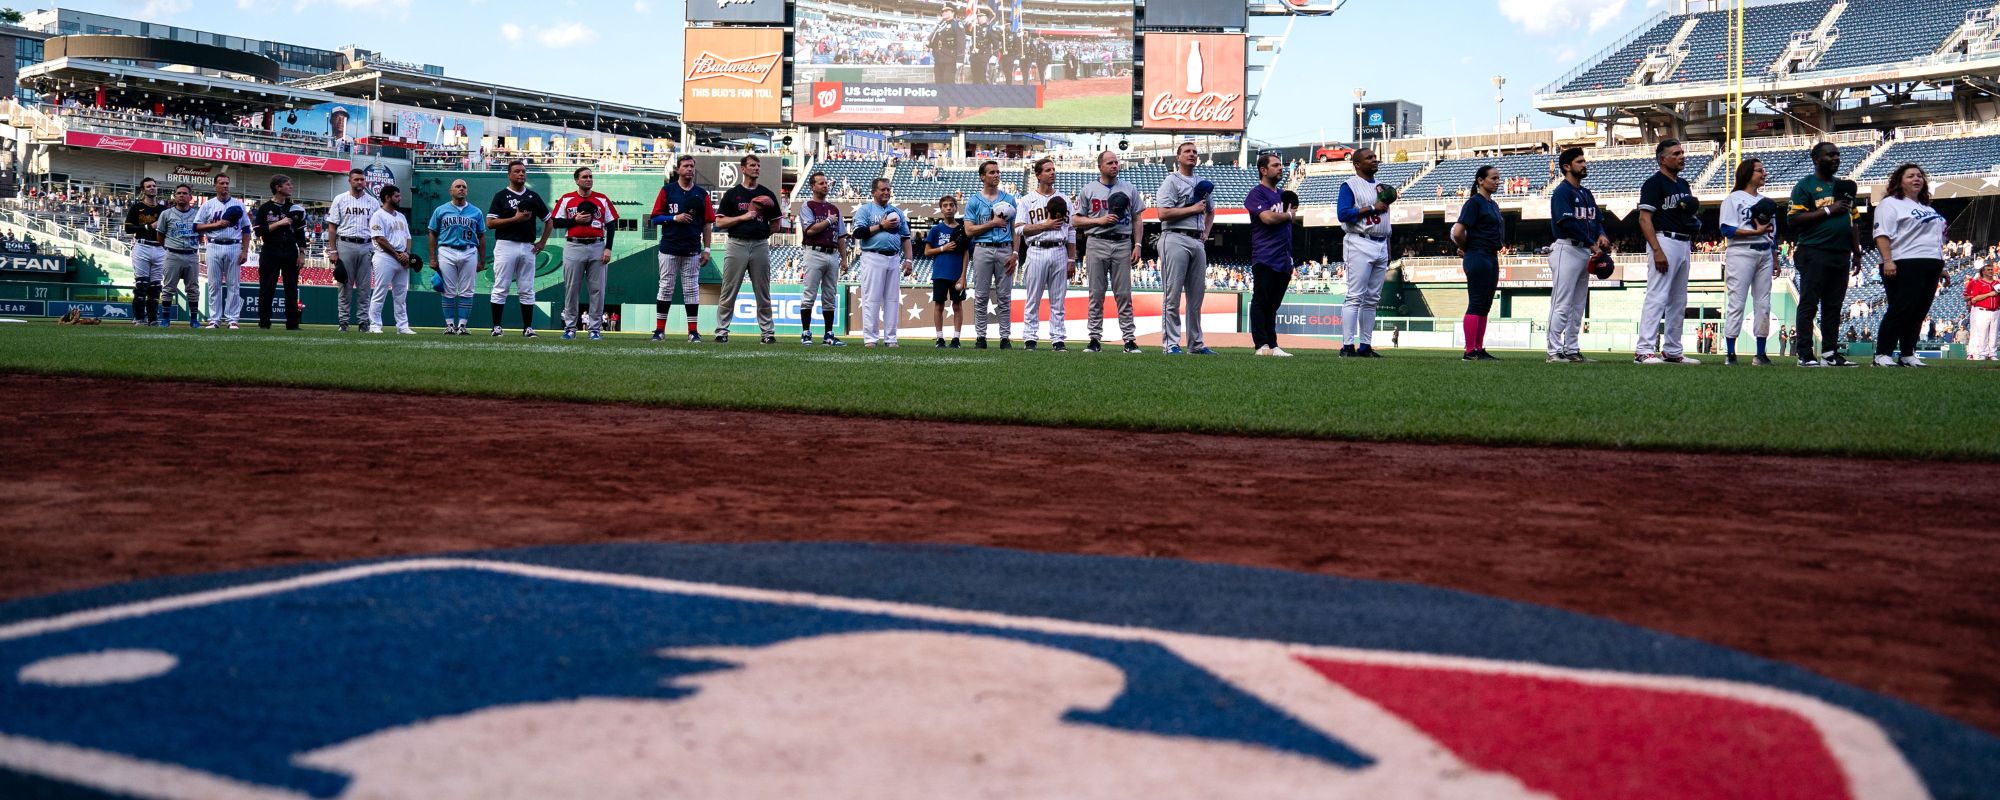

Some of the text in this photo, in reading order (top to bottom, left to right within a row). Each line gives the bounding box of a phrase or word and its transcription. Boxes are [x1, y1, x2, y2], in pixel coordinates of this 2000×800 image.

[693, 57, 770, 73] Budweiser
[692, 88, 774, 98] THIS BUD'S FOR YOU.
[844, 87, 938, 98] US Capitol Police
[1356, 127, 1378, 135] BYOND
[162, 142, 272, 164] THIS BUD'S FOR YOU.
[168, 174, 191, 183] BREW
[365, 176, 394, 186] HAMPIONS
[345, 207, 371, 216] ARMY
[668, 203, 679, 214] 38
[462, 229, 473, 240] 19
[13, 258, 60, 271] FAN
[34, 287, 48, 298] 377
[247, 297, 286, 305] PEFE
[68, 304, 94, 312] MGM
[1275, 315, 1344, 326] TURE GLOBA
